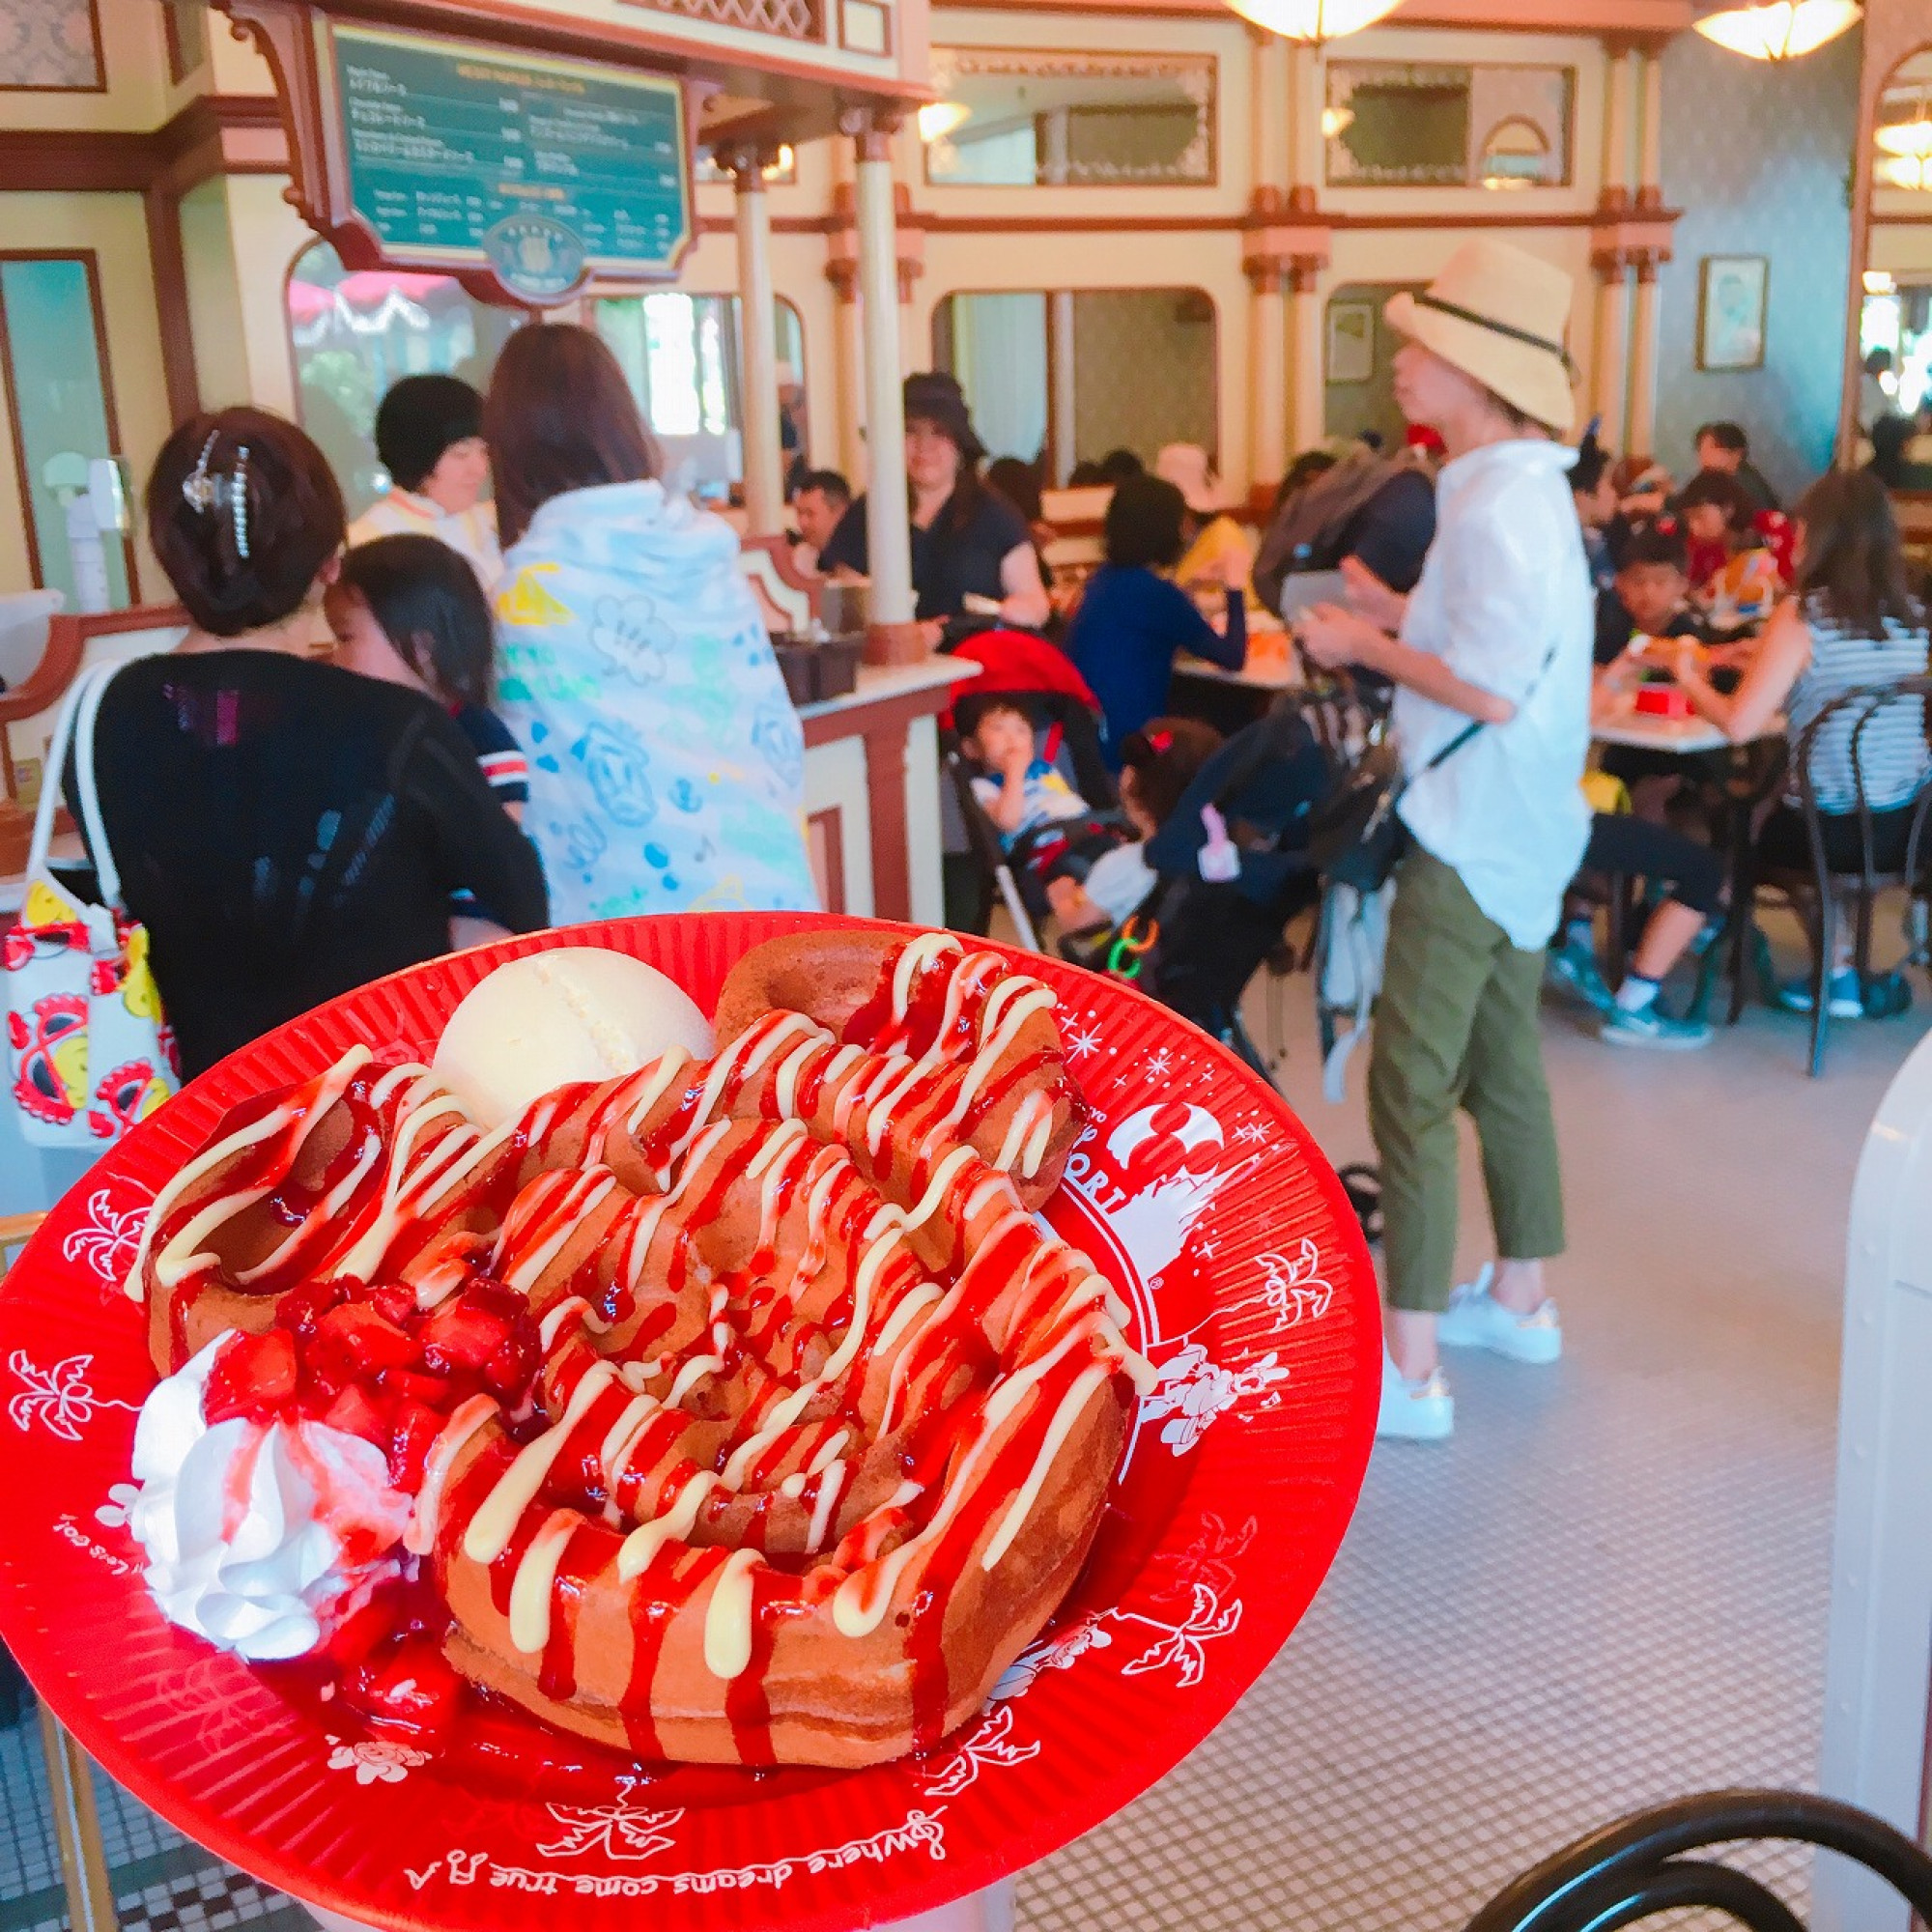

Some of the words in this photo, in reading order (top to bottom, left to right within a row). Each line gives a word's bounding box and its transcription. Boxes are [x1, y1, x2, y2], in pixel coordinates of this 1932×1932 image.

[1065, 1152, 1126, 1210] ORT
[490, 1869, 557, 1895] true
[575, 1877, 659, 1897] come
[673, 1861, 792, 1894] dreams
